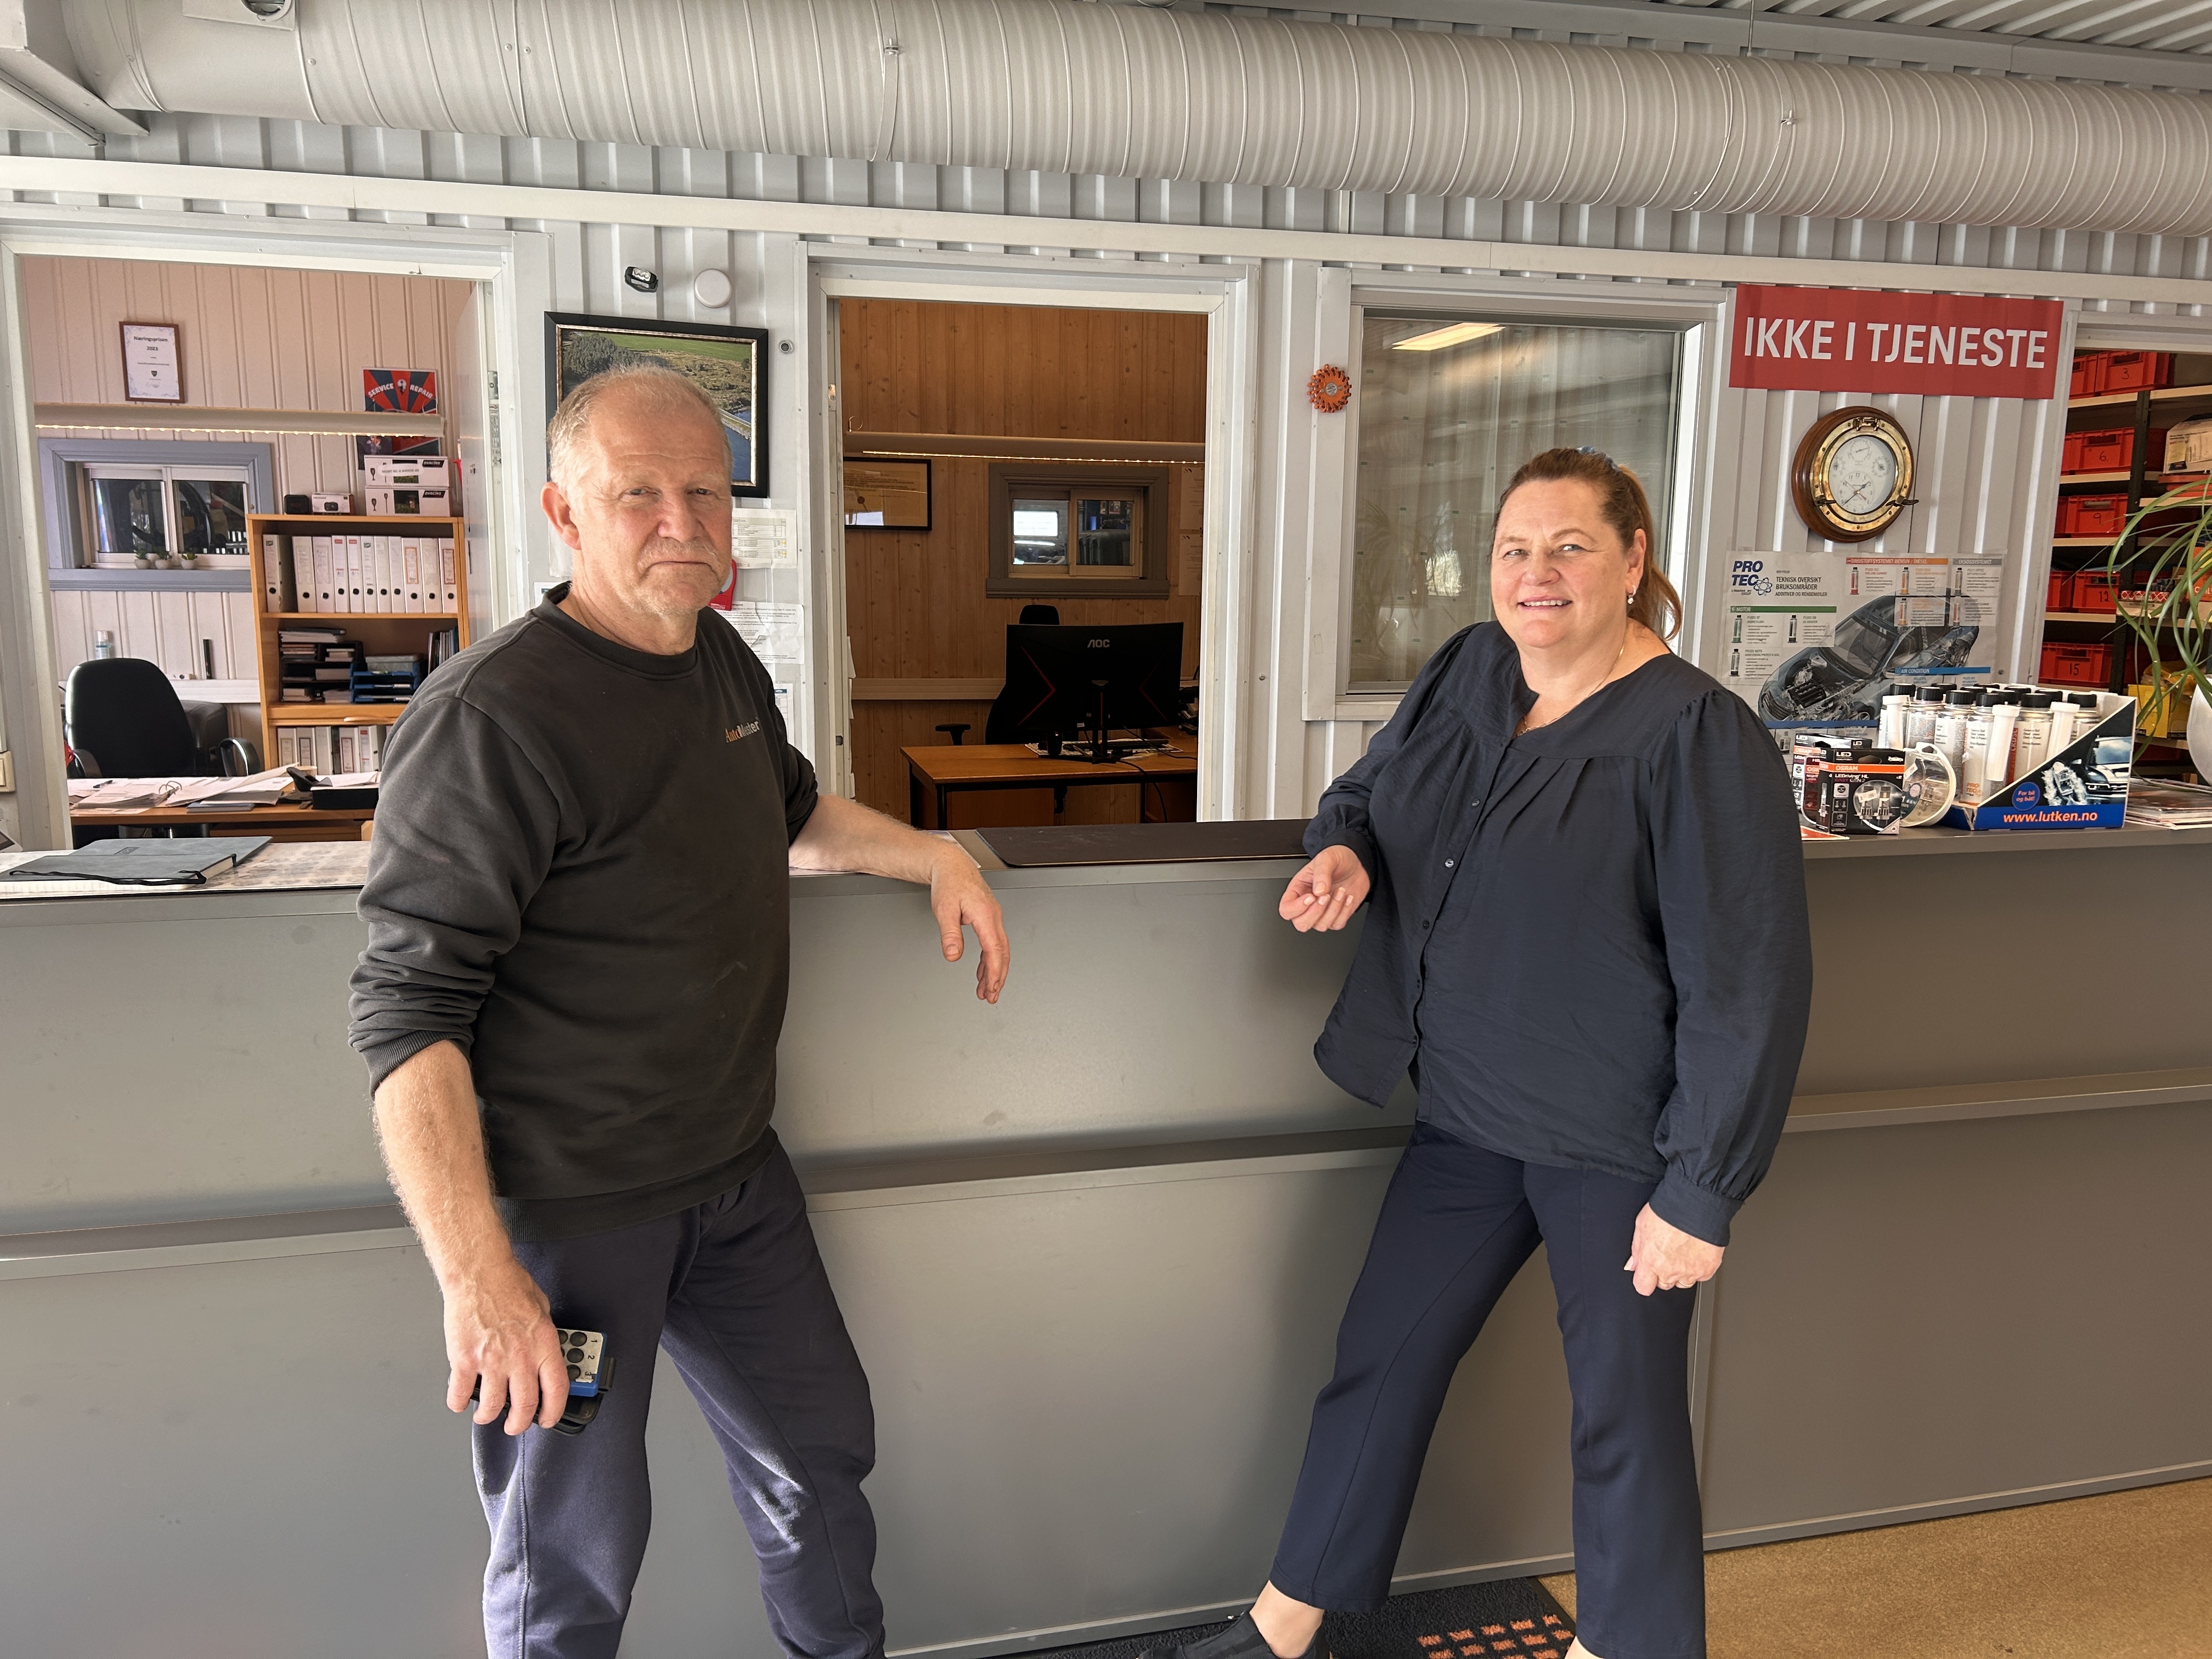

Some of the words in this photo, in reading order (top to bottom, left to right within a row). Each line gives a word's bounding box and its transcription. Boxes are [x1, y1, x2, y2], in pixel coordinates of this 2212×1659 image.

[1745, 317, 1835, 360] IKKE
[1845, 321, 1856, 360] I
[1867, 323, 2048, 369] TJENESTE
[368, 383, 394, 398] SERVICE
[410, 385, 433, 399] REPAIR
[2093, 512, 2102, 525] 9
[1733, 561, 1763, 572] PRO
[1731, 574, 1759, 586] TEC
[2098, 590, 2109, 602] 12
[1087, 639, 1110, 648] AOC
[2069, 662, 2080, 675] 15
[2003, 811, 2098, 822] www.lutken.no
